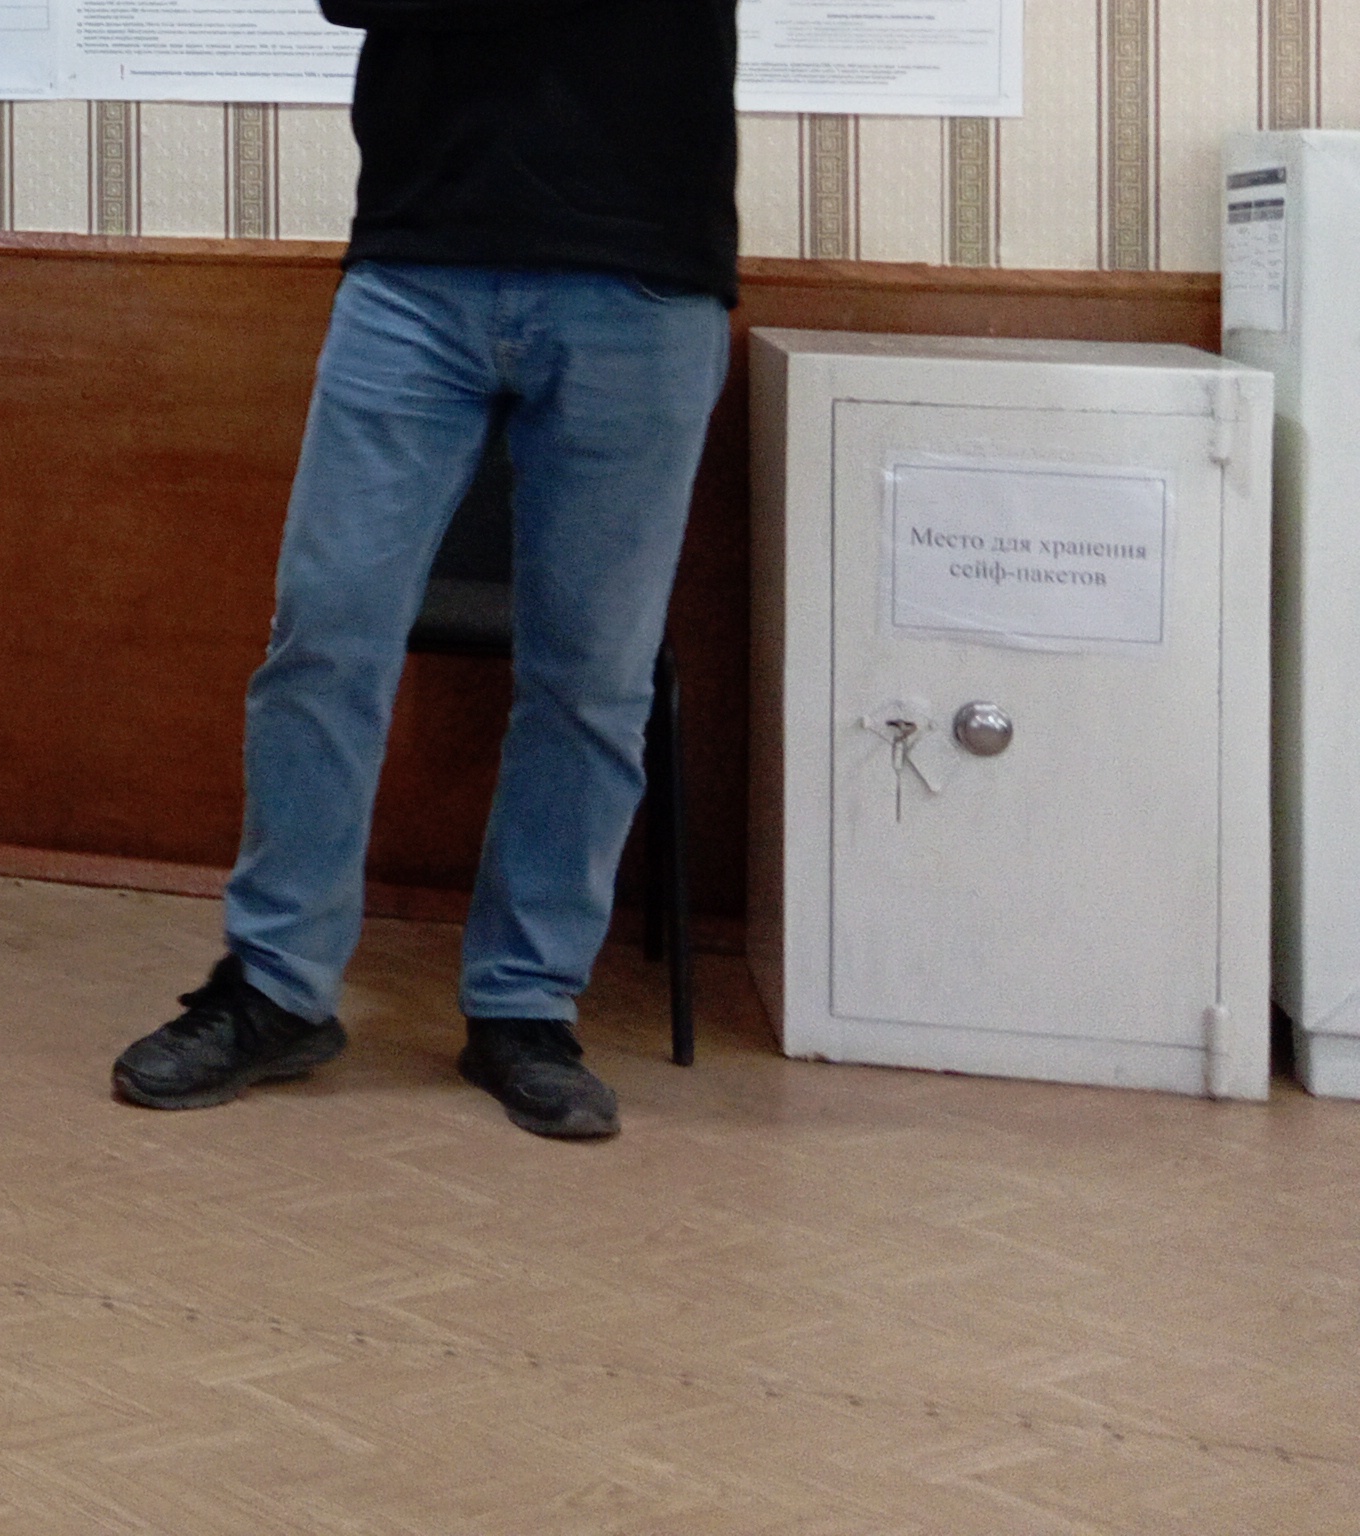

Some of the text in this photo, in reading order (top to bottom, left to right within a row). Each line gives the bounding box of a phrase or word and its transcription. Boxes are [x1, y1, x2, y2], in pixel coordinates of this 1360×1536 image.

[910, 526, 1147, 560] Место для хранения
[949, 560, 1107, 587] сейф-пакетов
